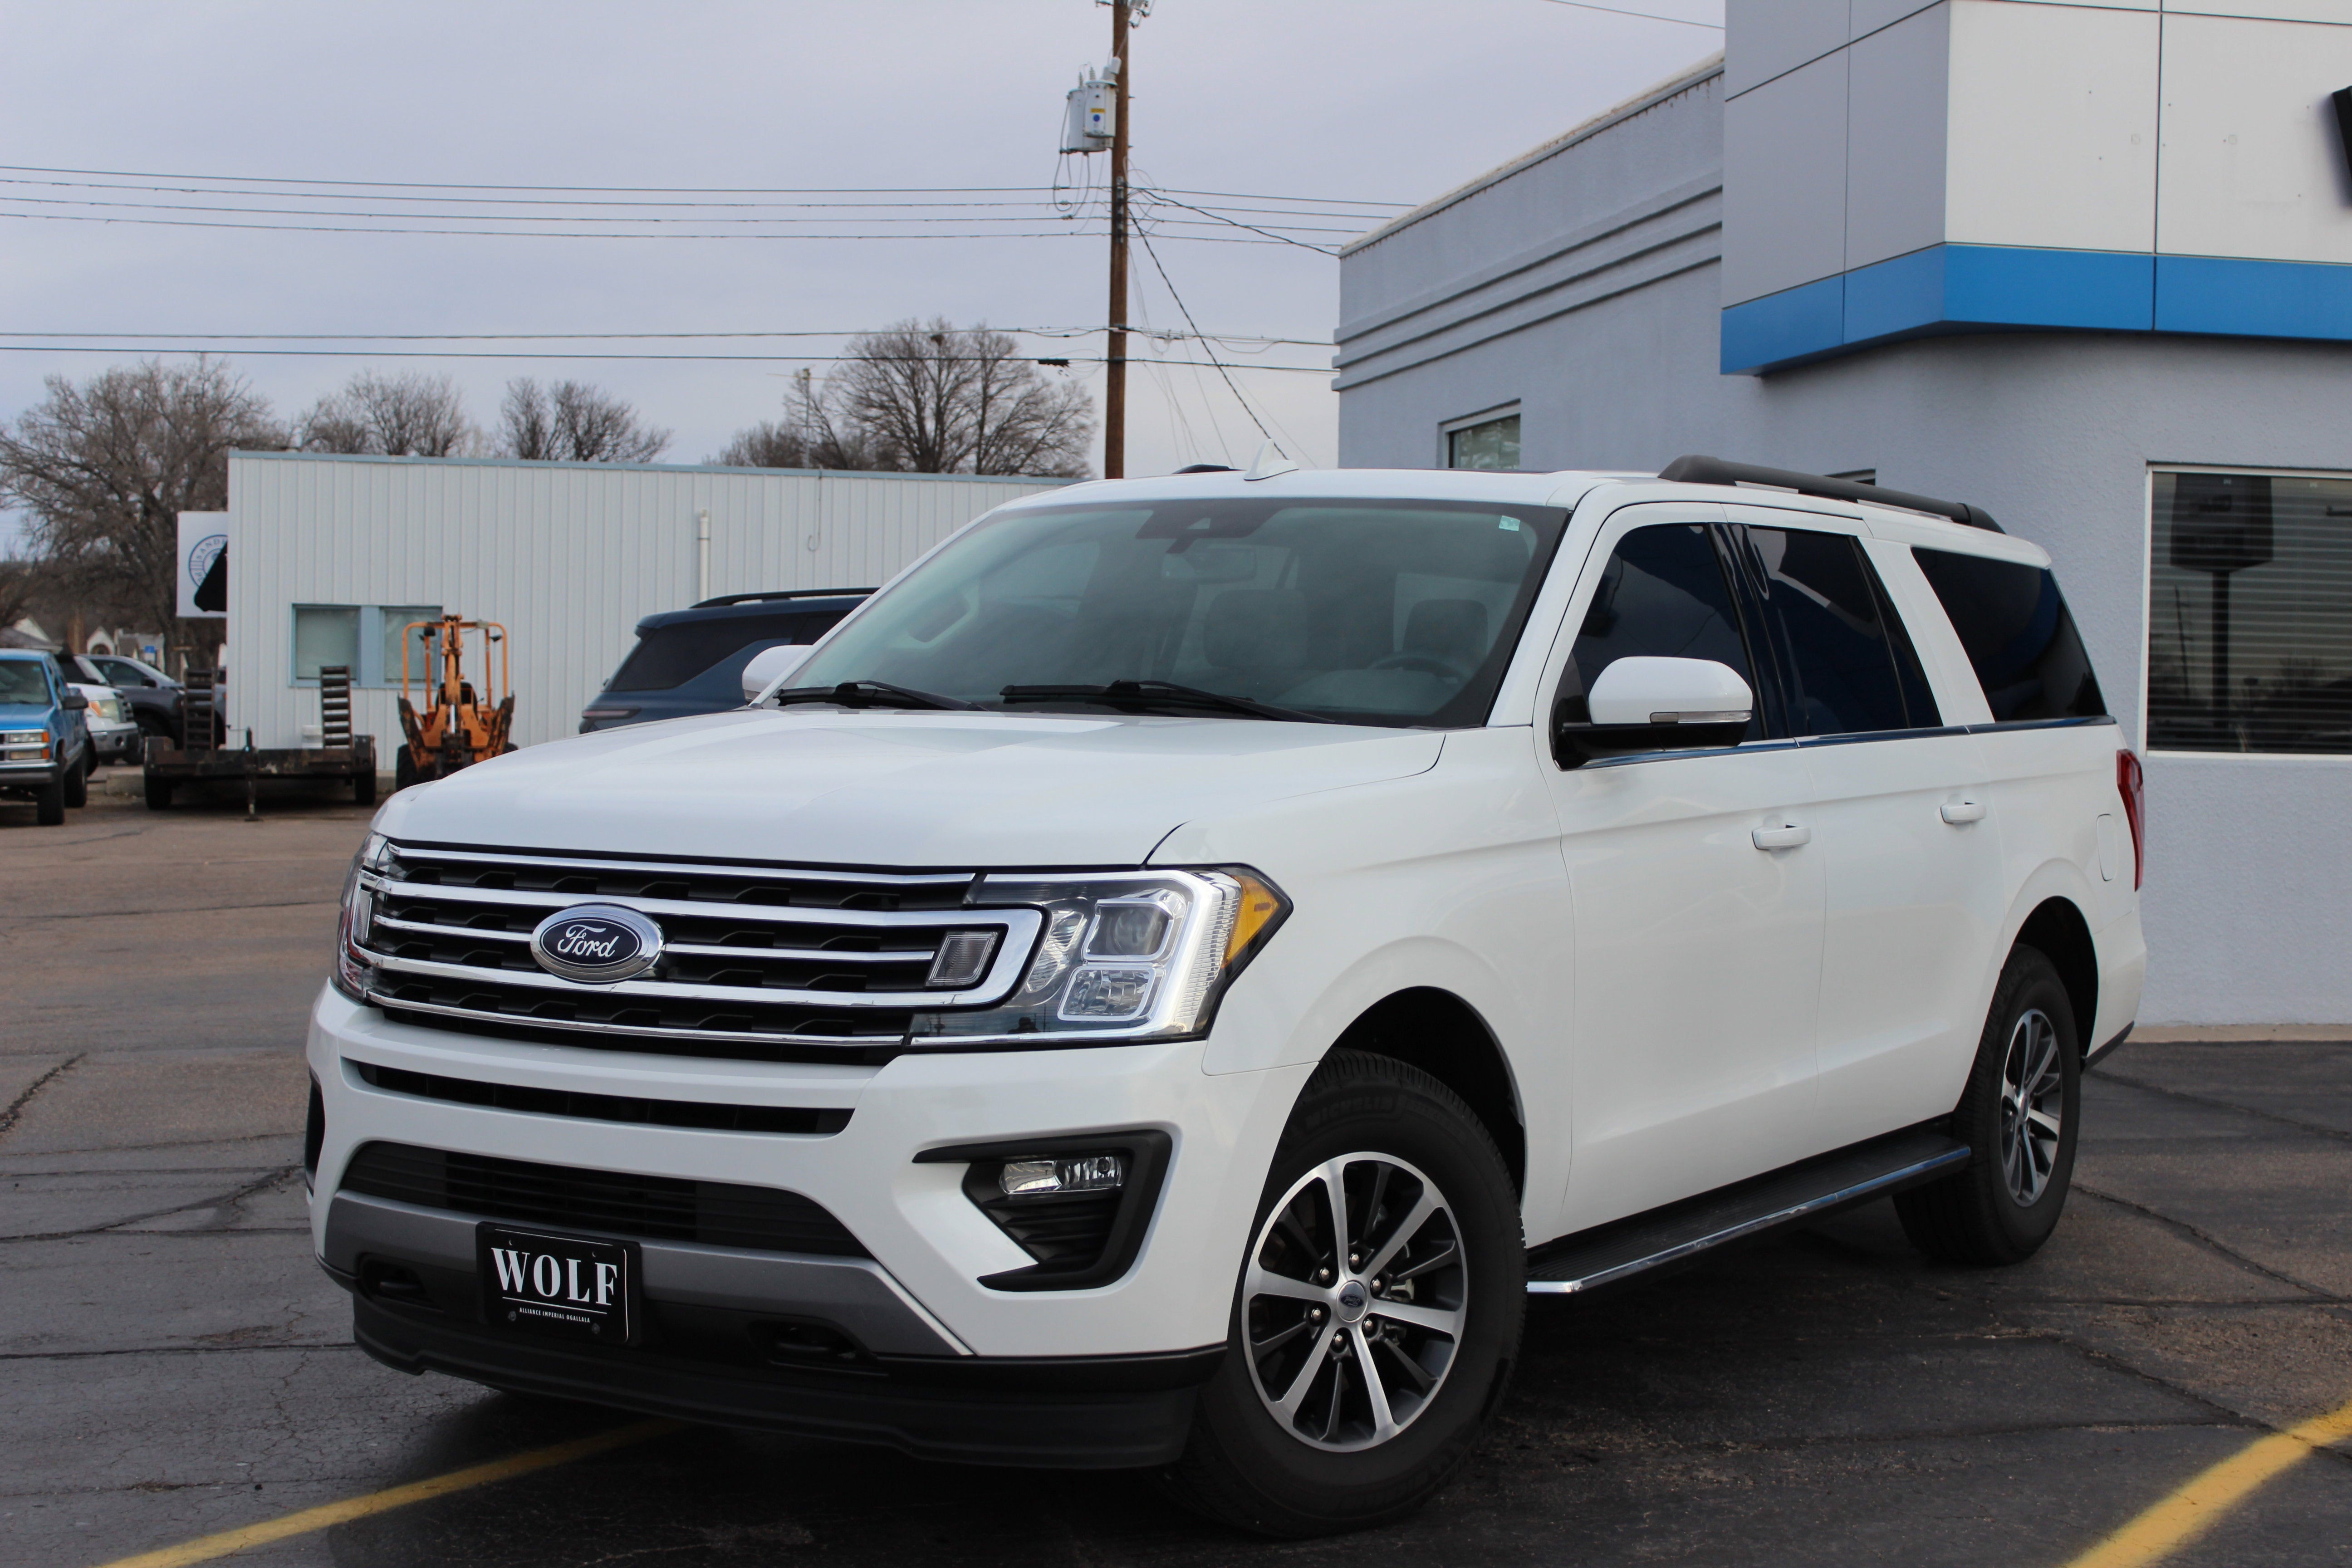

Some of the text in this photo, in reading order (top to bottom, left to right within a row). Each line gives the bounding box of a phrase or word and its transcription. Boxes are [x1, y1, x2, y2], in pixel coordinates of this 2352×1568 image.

[558, 924, 619, 957] Ford
[491, 1247, 617, 1306] WOLF
[1344, 1296, 1360, 1306] Ford
[519, 1307, 590, 1323] ALLIANCE IMPERIAL OGALLALA
